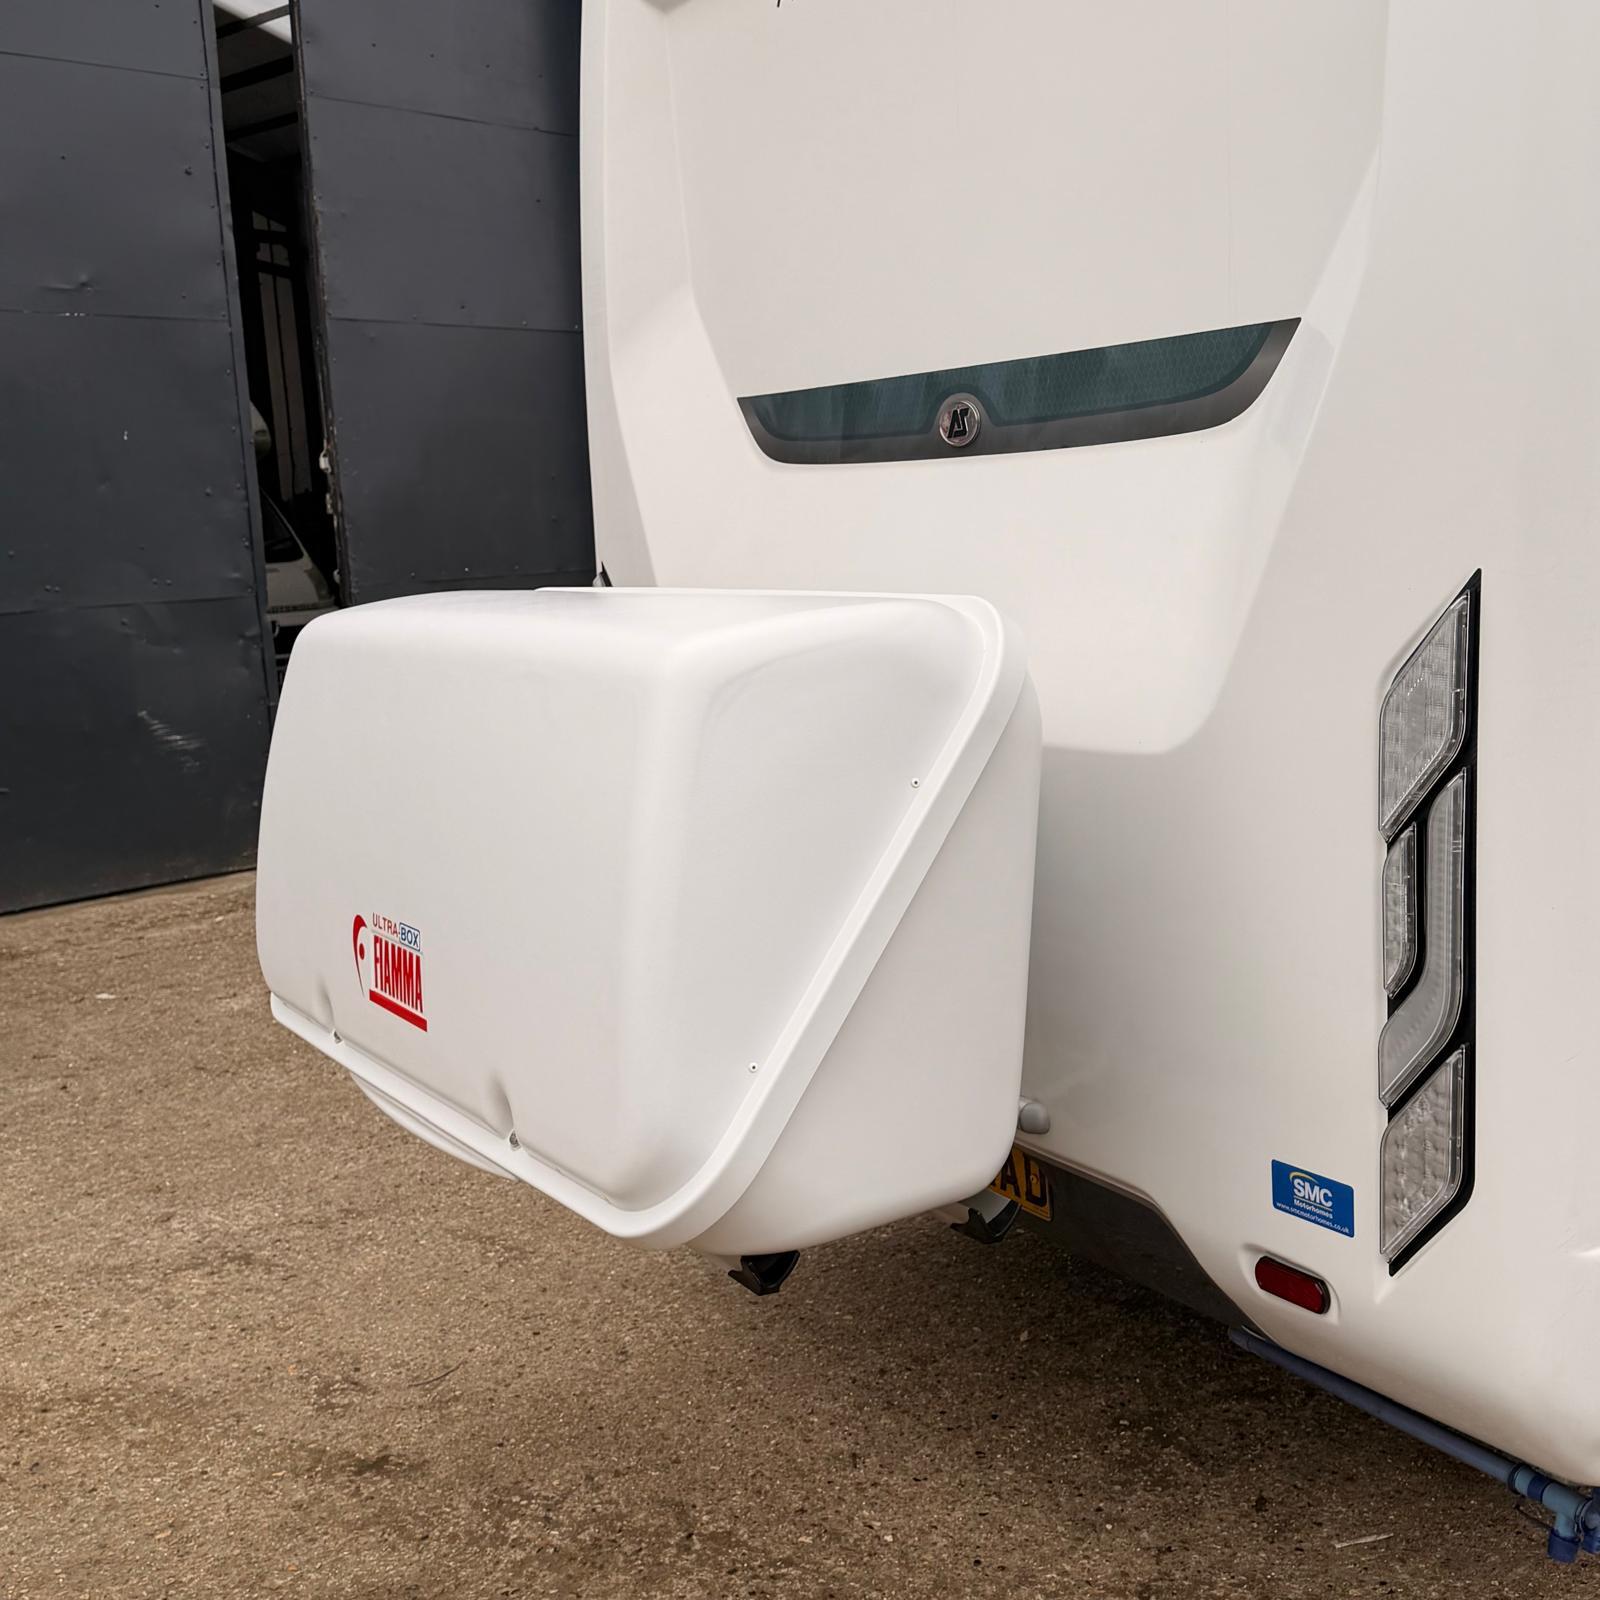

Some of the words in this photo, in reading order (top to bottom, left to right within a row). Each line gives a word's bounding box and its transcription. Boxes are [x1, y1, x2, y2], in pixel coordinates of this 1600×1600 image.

[373, 934, 424, 1014] FIAMMA
[1293, 1178, 1333, 1208] SMC
[1293, 1199, 1334, 1219] Motorhomes
